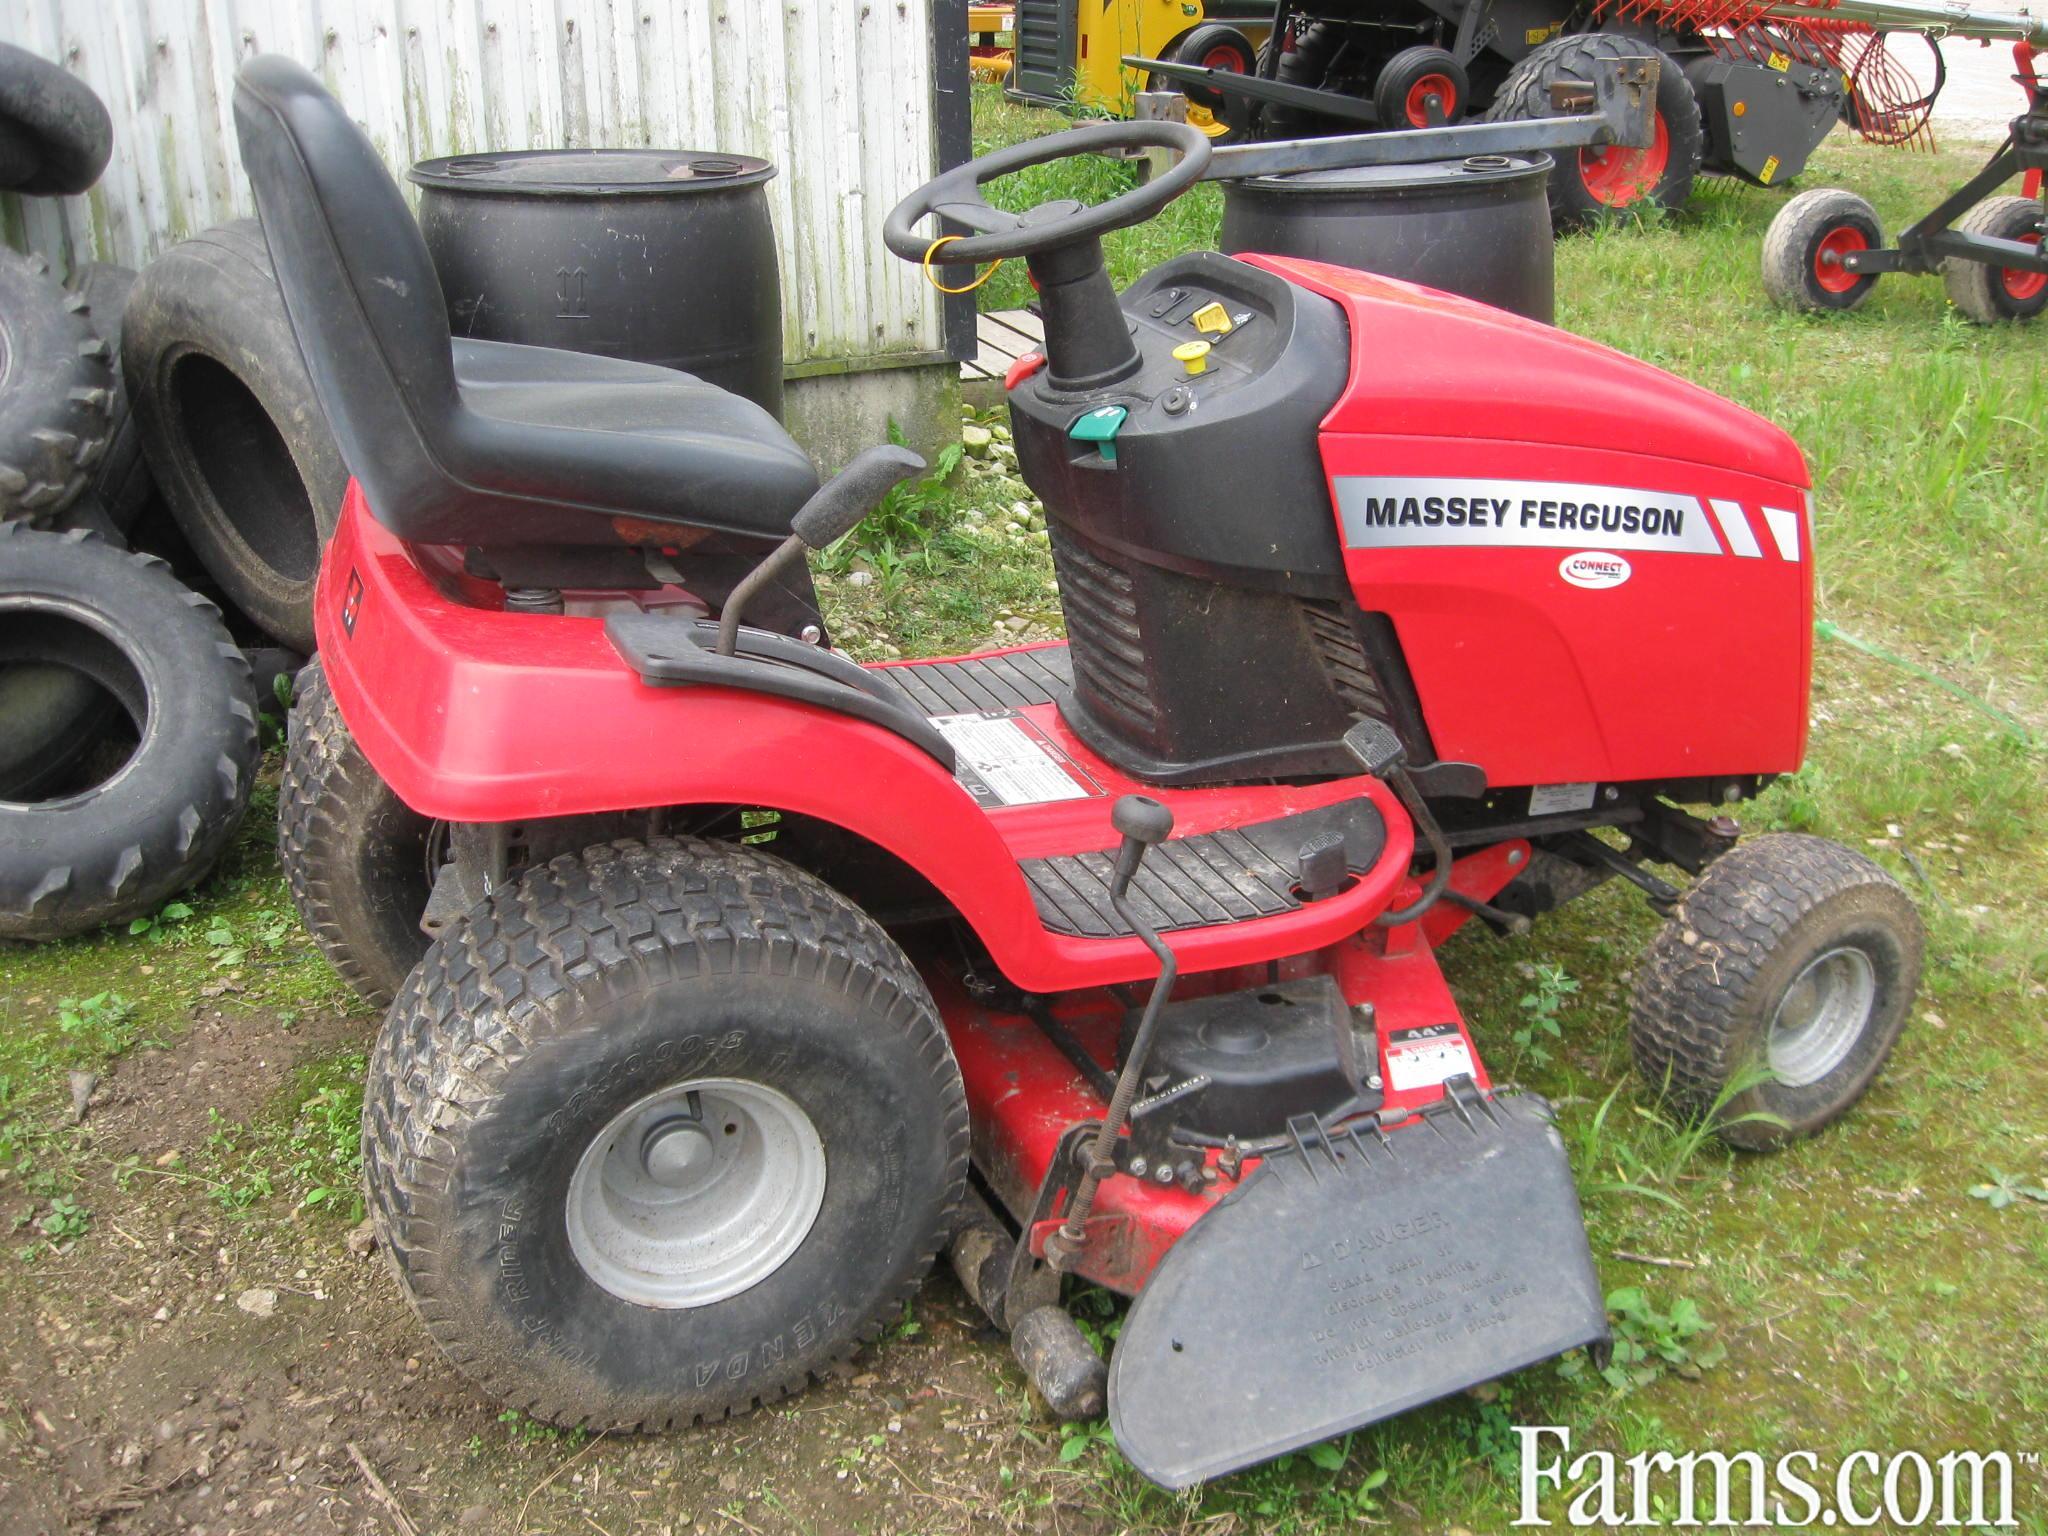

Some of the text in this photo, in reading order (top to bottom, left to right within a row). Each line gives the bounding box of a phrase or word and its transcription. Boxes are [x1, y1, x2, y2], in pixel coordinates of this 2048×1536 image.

[1365, 497, 1684, 536] MASSEY FERGUSON
[1573, 560, 1622, 572] CONNECT
[498, 1196, 531, 1304] RIDER
[1329, 1210, 1450, 1261] DANGER
[695, 1300, 846, 1388] KENDA
